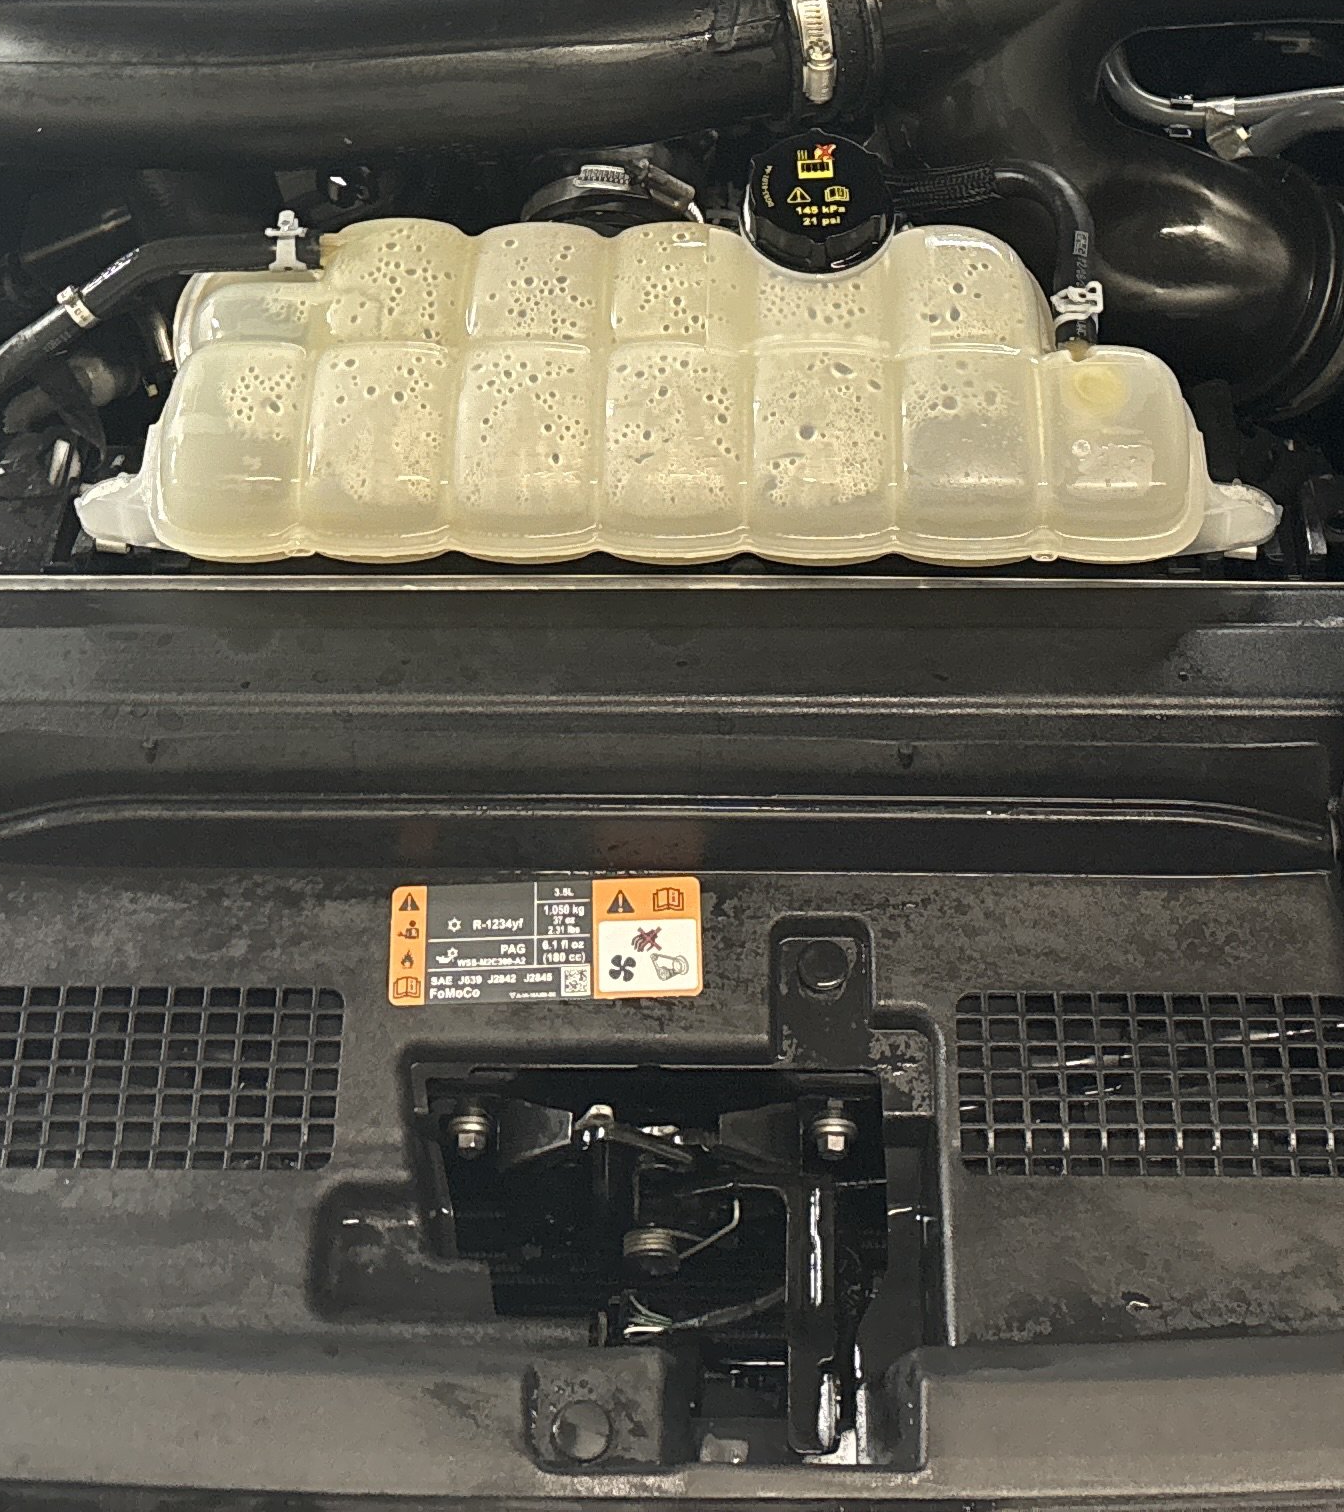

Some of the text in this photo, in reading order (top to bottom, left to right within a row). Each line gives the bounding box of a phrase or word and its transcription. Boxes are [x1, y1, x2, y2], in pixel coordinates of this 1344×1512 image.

[795, 204, 846, 215] 145 kPa
[802, 216, 841, 227] 21 psi
[572, 904, 585, 917] kg
[472, 918, 524, 932] R-1234yf
[553, 916, 576, 926] 37 oz
[548, 925, 581, 936] 2.31 lbs
[500, 943, 526, 955] PAG
[542, 939, 585, 951] 6.1 fl oz
[543, 951, 586, 965] (180 cc)
[430, 972, 553, 986] SAE J639 J2842 J2845
[429, 986, 481, 1000] FoMoCo
